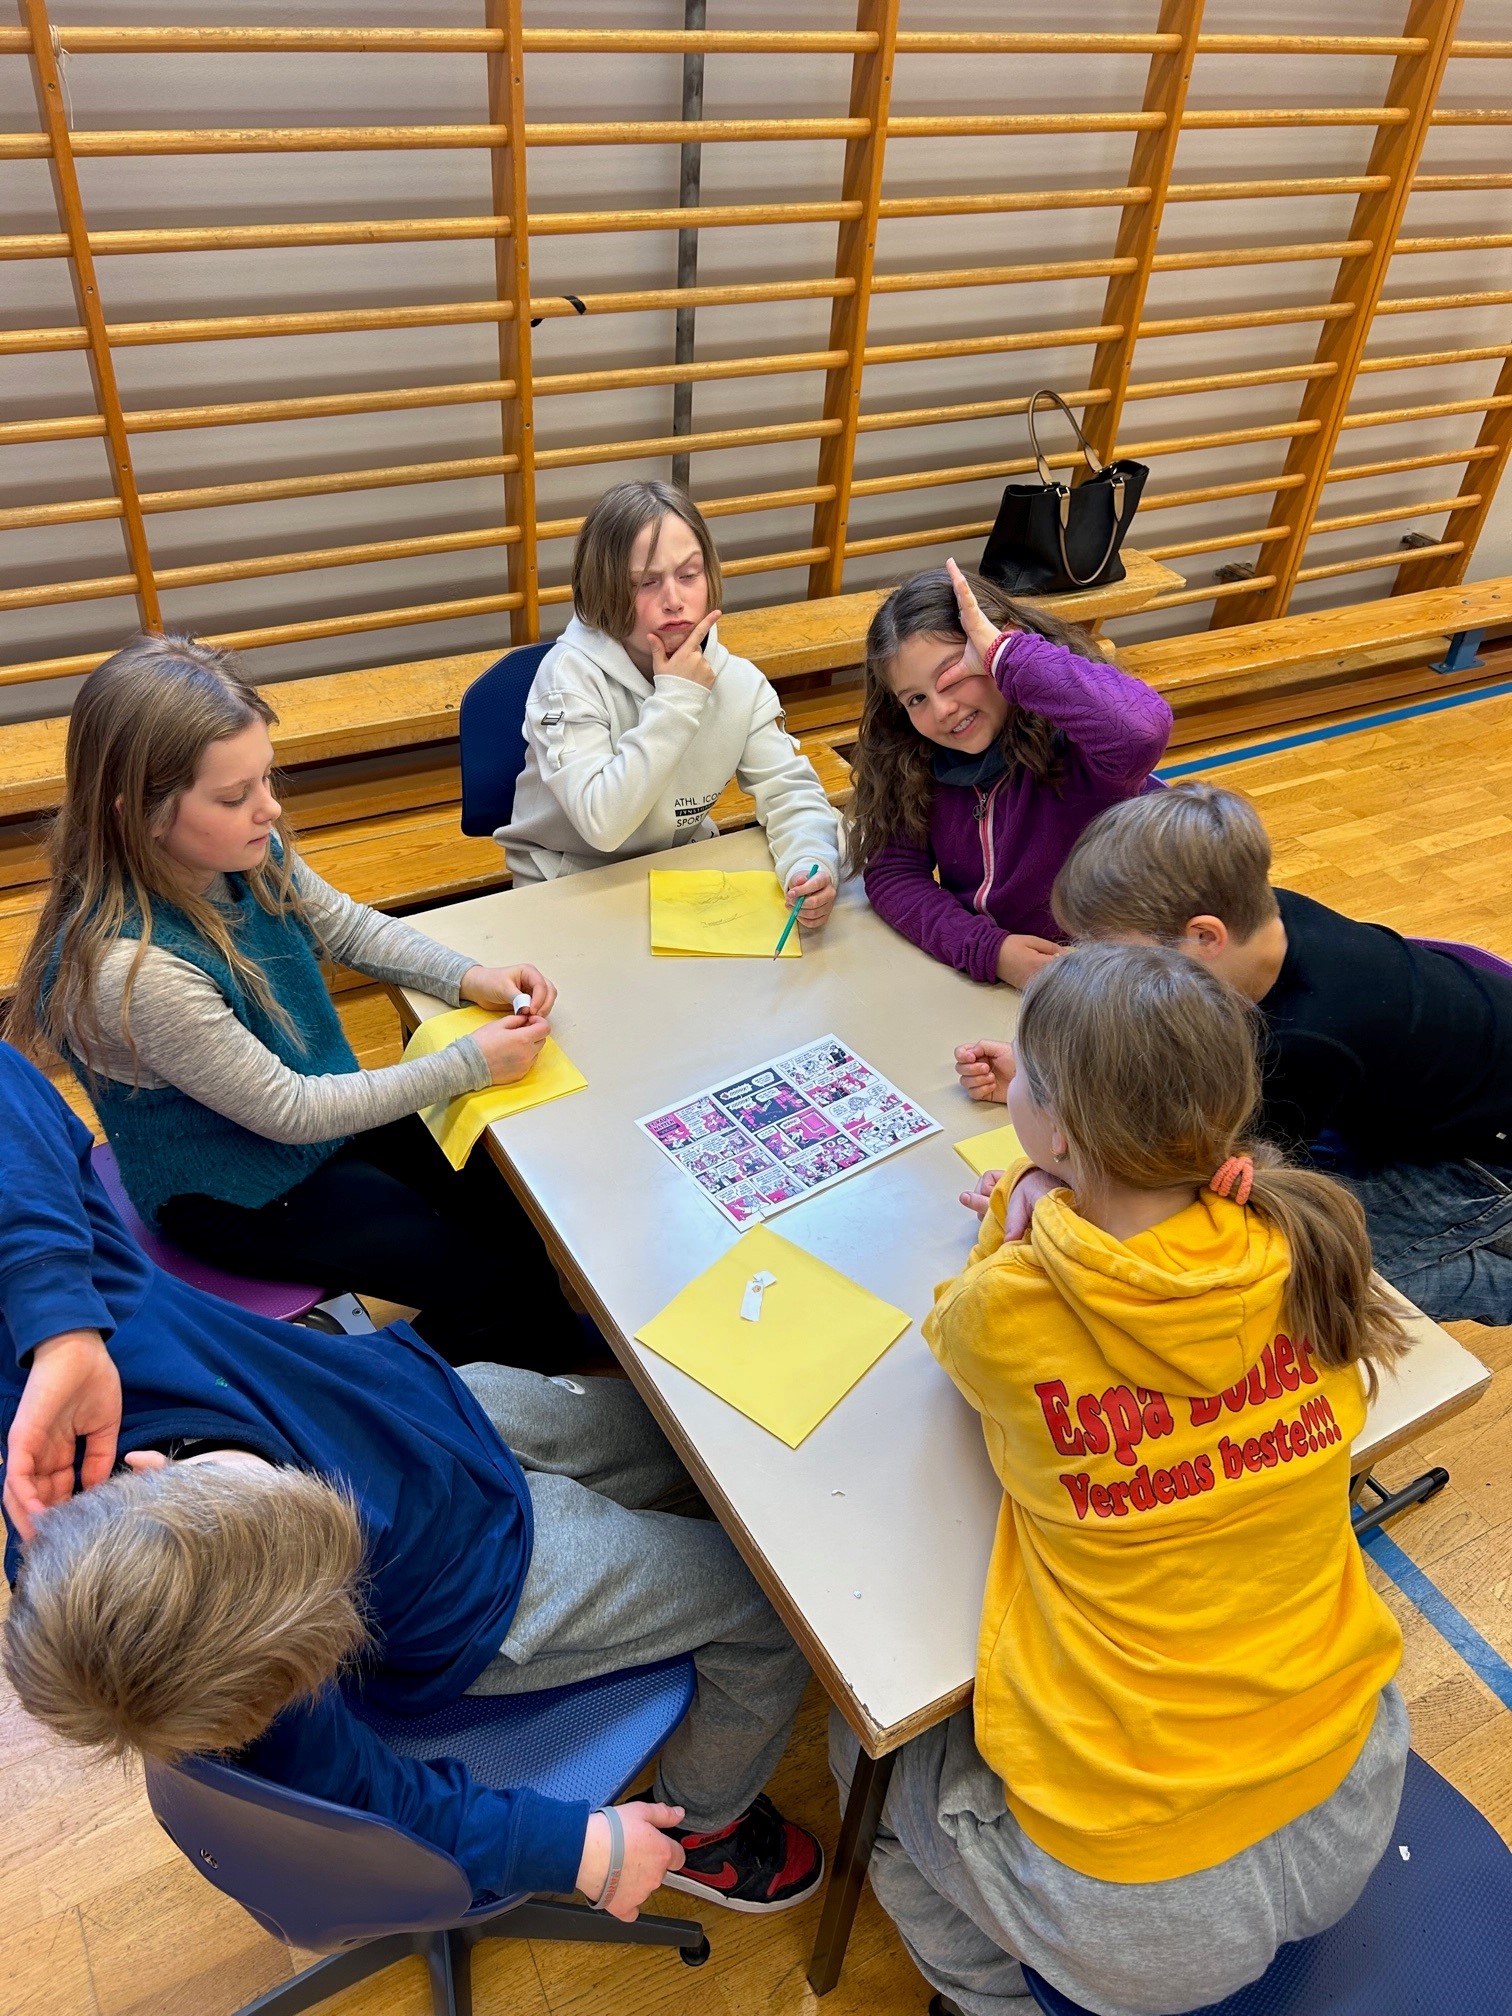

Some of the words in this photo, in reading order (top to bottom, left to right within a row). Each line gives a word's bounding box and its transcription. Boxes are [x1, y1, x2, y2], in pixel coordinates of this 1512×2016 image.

[676, 813, 705, 827] SPORT
[1034, 1379, 1174, 1466] Espa
[1060, 1454, 1215, 1520] Verdens
[1218, 1394, 1342, 1479] beste!!!!
